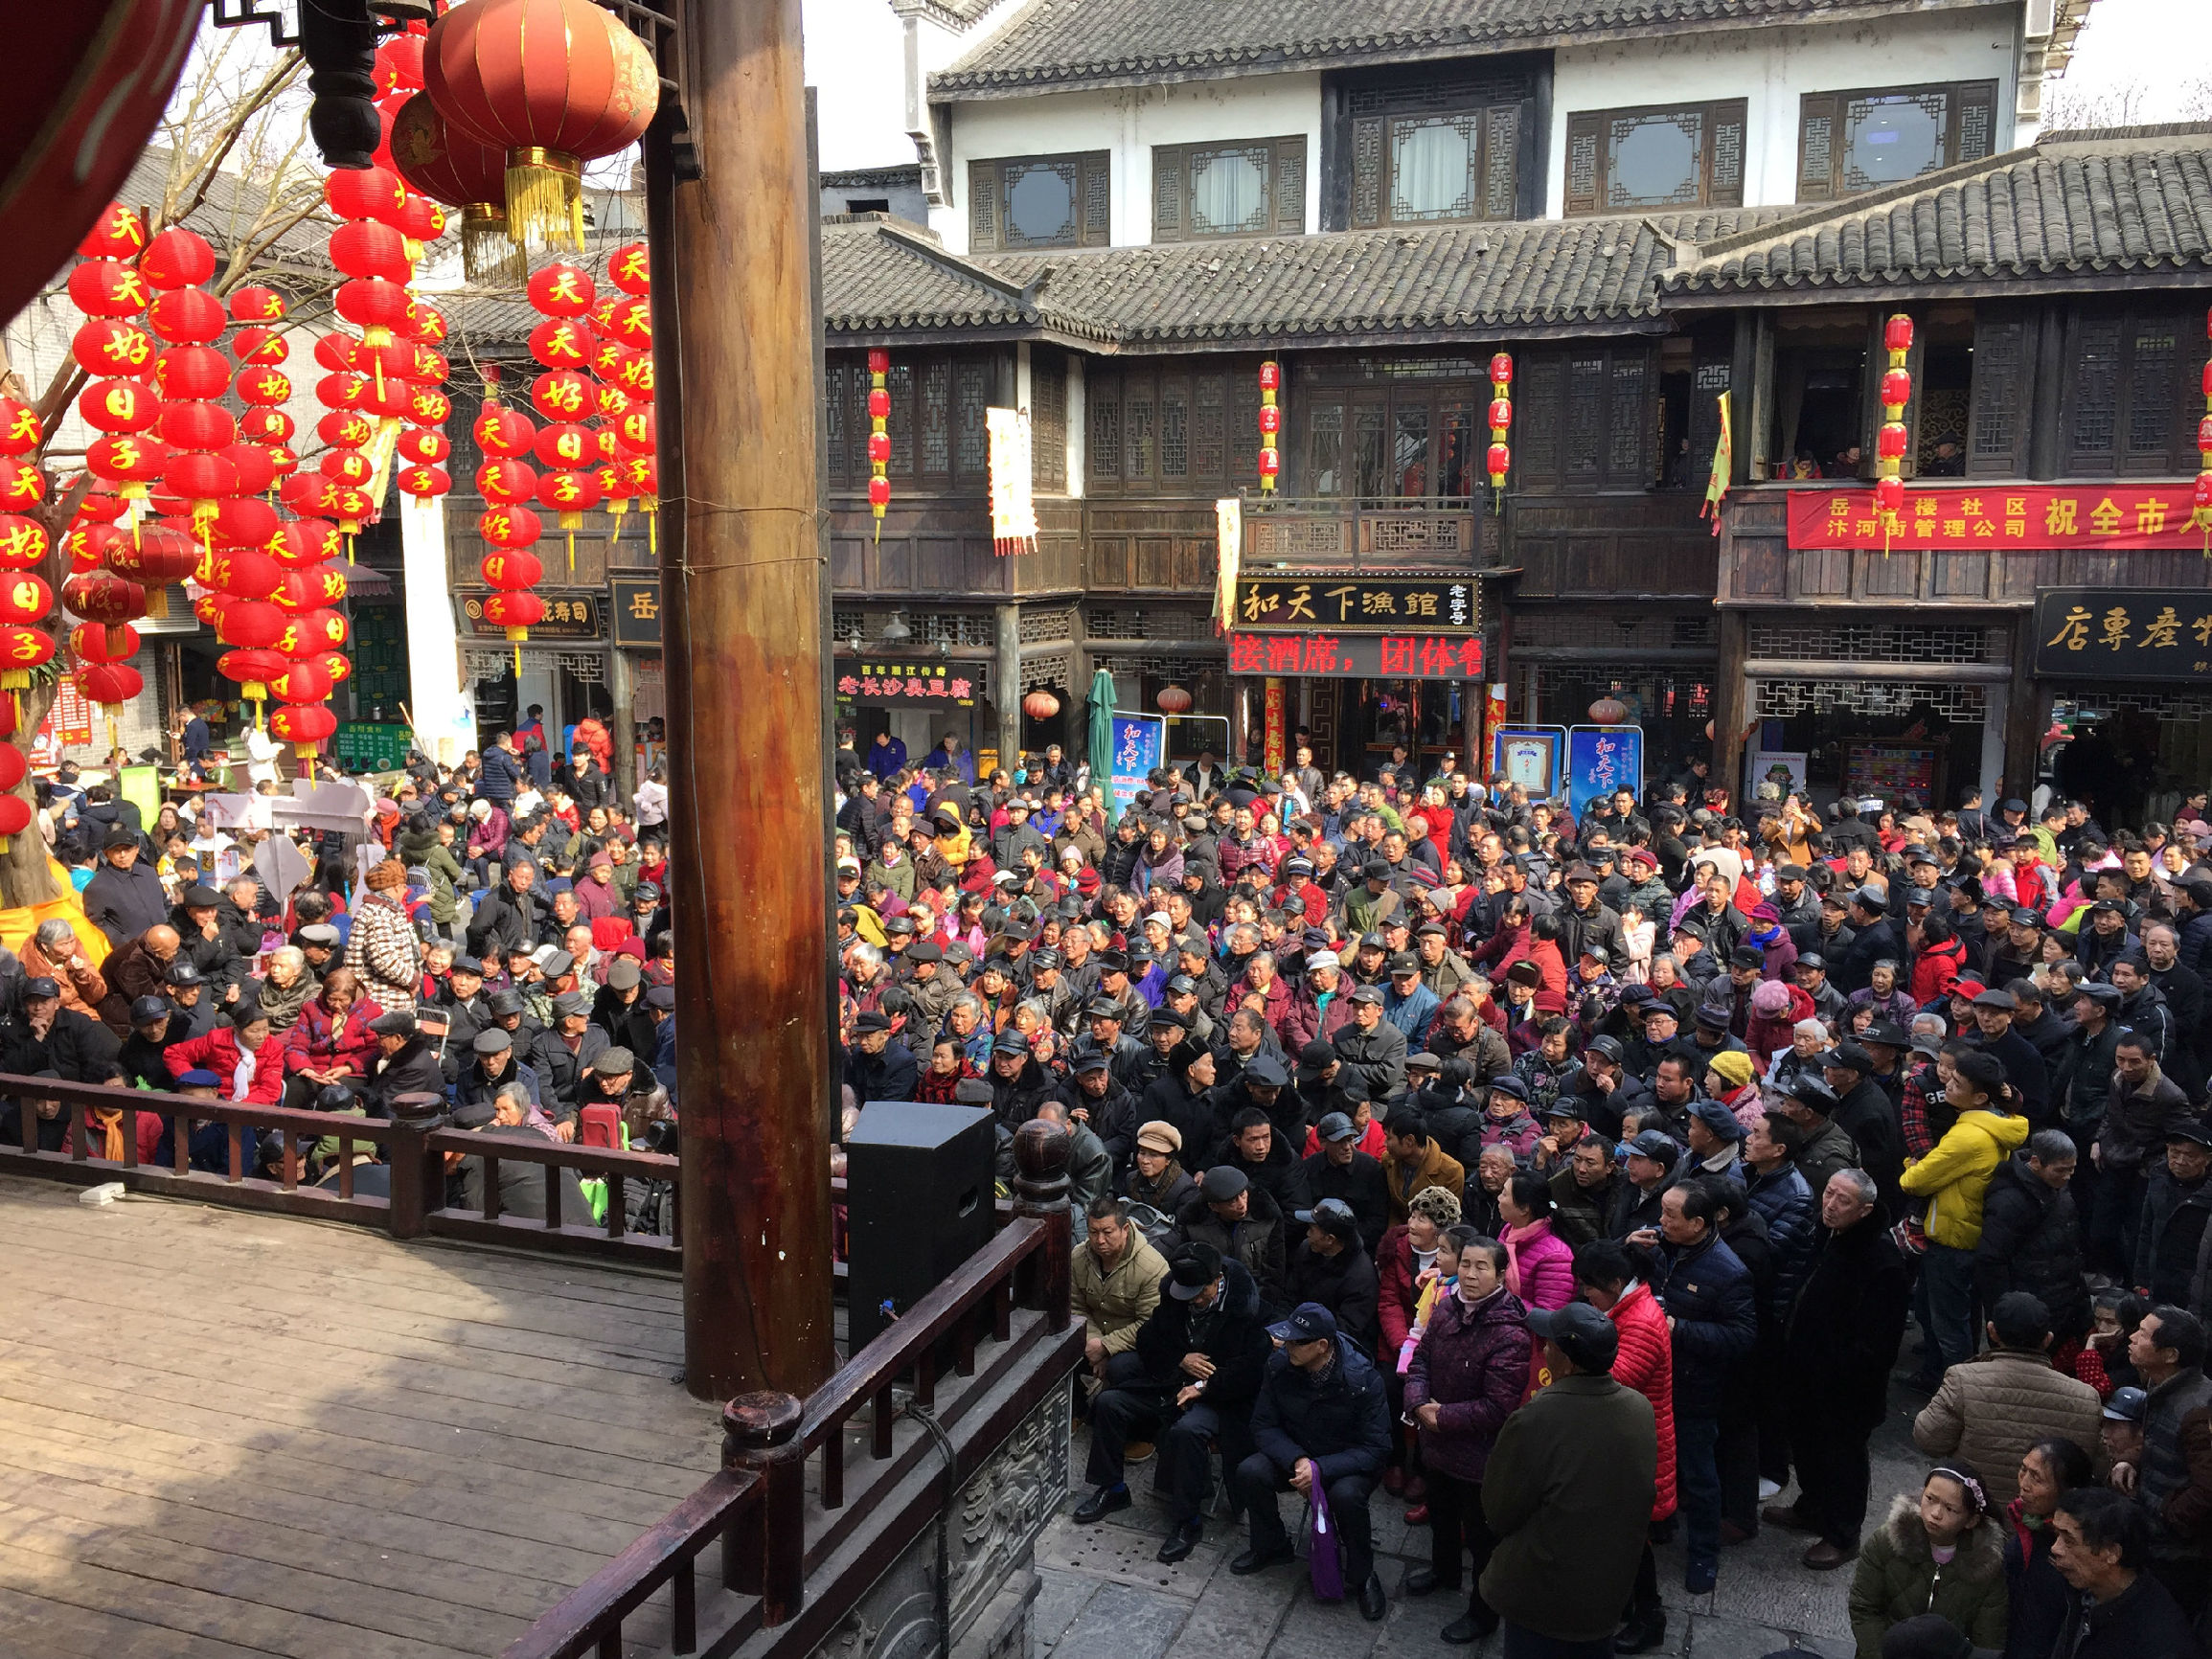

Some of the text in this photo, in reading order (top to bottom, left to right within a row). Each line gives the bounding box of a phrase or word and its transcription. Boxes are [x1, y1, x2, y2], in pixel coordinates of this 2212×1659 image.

[103, 208, 149, 469] 天天好日子
[541, 272, 584, 503] 天天好日子
[479, 419, 511, 619] 天天好日子
[1827, 519, 2025, 537] 汴河街管理公司
[1829, 498, 2026, 516] 岳楼社区
[0, 409, 45, 660] 天天好日子
[1243, 583, 1439, 622] 和天下漁館
[1449, 584, 1468, 625] 老字号
[838, 675, 971, 698] 老长沙臭豆腐
[1123, 723, 1141, 771] 和天下
[1596, 738, 1615, 789] 和天下
